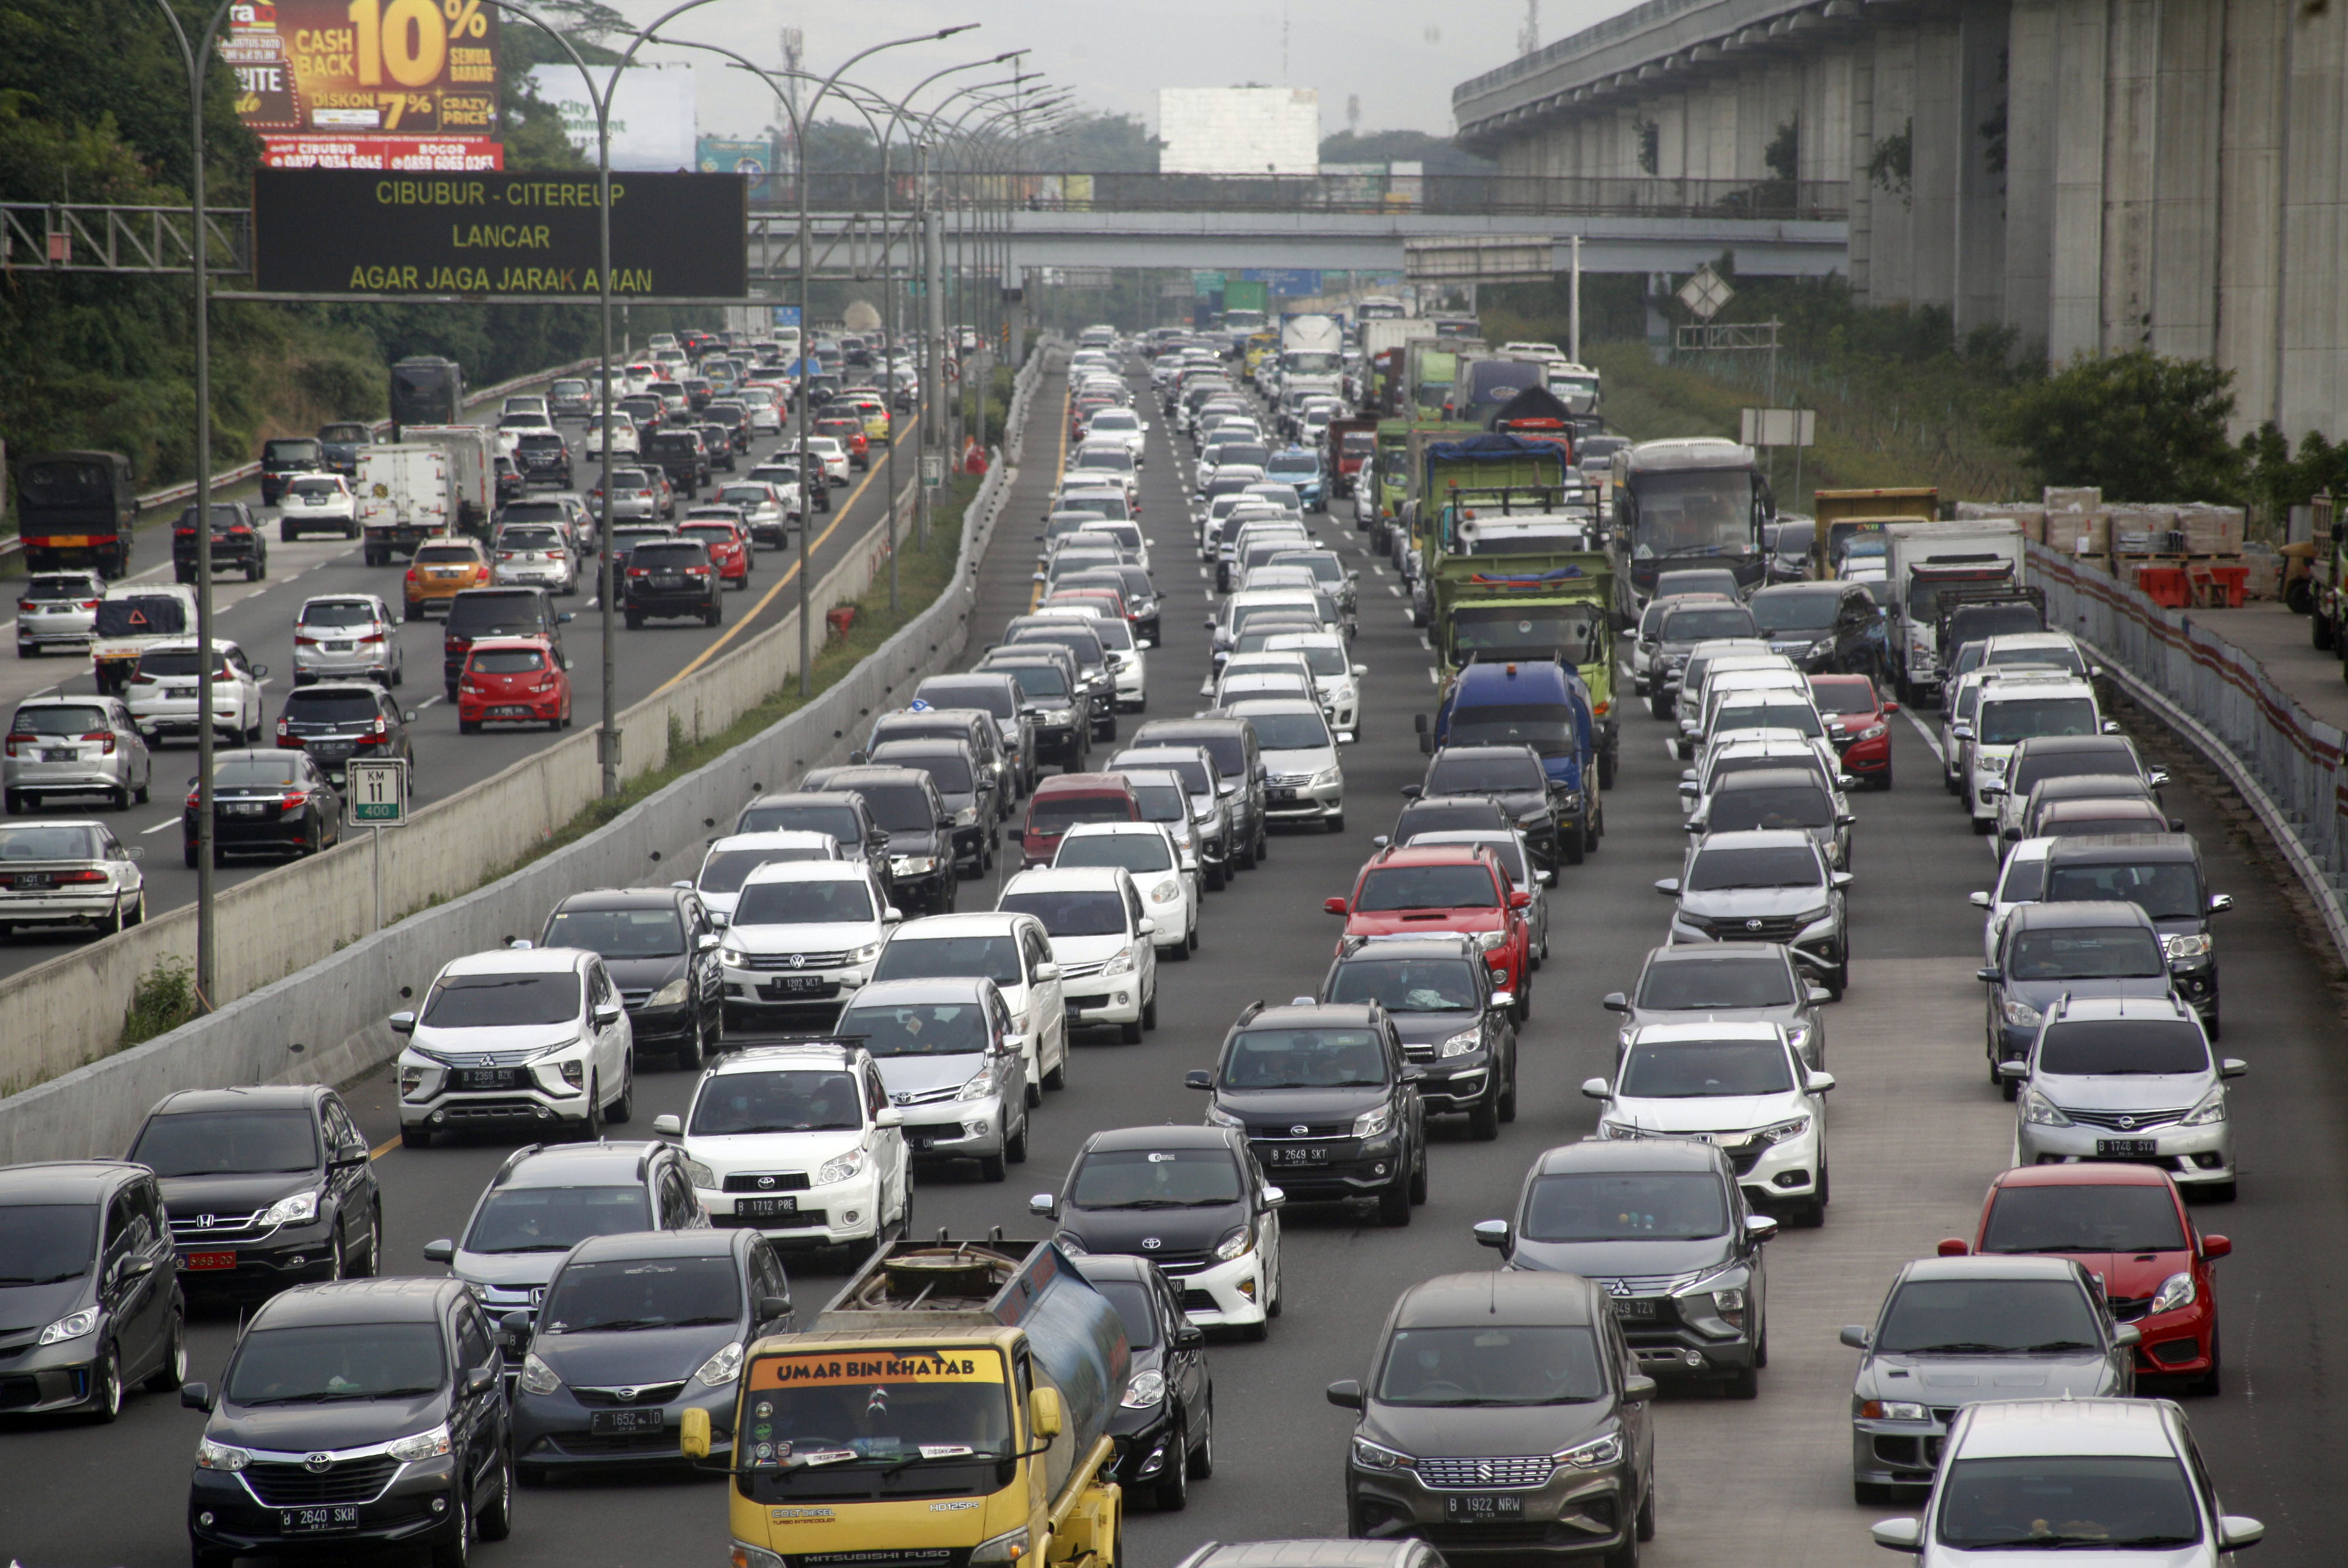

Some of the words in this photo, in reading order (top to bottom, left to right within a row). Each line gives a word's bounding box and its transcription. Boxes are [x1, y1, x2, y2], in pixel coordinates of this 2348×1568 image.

[230, 4, 277, 22] ra10
[296, 29, 352, 53] CASH
[348, 0, 487, 87] 10%
[298, 54, 354, 77] BACK
[313, 93, 374, 107] DISKON
[443, 97, 488, 110] CRAZY
[558, 99, 589, 117] City
[443, 111, 488, 124] PRICE
[298, 144, 357, 155] CIBUBUR
[419, 144, 466, 155] BOGOR
[376, 181, 485, 205] CIBUBUR
[453, 225, 550, 248] LANCAR
[350, 266, 419, 289] AGAR
[426, 267, 490, 290] JAGA
[497, 268, 576, 292] JARAK
[368, 771, 384, 780] KM
[369, 783, 383, 802] 11
[365, 806, 390, 817] 400
[777, 981, 781, 989] B
[787, 979, 804, 988] 1202
[806, 978, 818, 986] WLT
[464, 1073, 469, 1082] B
[475, 1072, 494, 1081] 2369
[498, 1072, 512, 1080] BZK
[2099, 1141, 2104, 1151] B
[2111, 1141, 2131, 1151] 1748
[2138, 1141, 2155, 1151] SYX
[1273, 1150, 1278, 1161] B
[1286, 1150, 1306, 1160] 2649
[1311, 1149, 1327, 1160] SKT
[738, 1201, 744, 1212] B
[753, 1201, 773, 1212] 1712
[1613, 1302, 1630, 1314] 349
[1637, 1302, 1654, 1314] TZV
[510, 1334, 516, 1346] B
[777, 1362, 841, 1382] UMAR
[846, 1360, 882, 1378] BIN
[886, 1359, 975, 1377] KHATAB
[593, 1415, 600, 1427] F
[612, 1413, 635, 1426] 1652
[649, 1412, 661, 1425] ID
[1450, 1499, 1457, 1512] B
[1467, 1498, 1492, 1511] 1922
[1498, 1496, 1520, 1511] NRW
[284, 1513, 291, 1526] B
[300, 1509, 328, 1525] 2640
[335, 1508, 356, 1523] SKH
[772, 1509, 801, 1518] COLT
[802, 1508, 836, 1518] DIESEL
[805, 1552, 899, 1563] MITSUBISHI
[905, 1550, 950, 1560] FUSO
